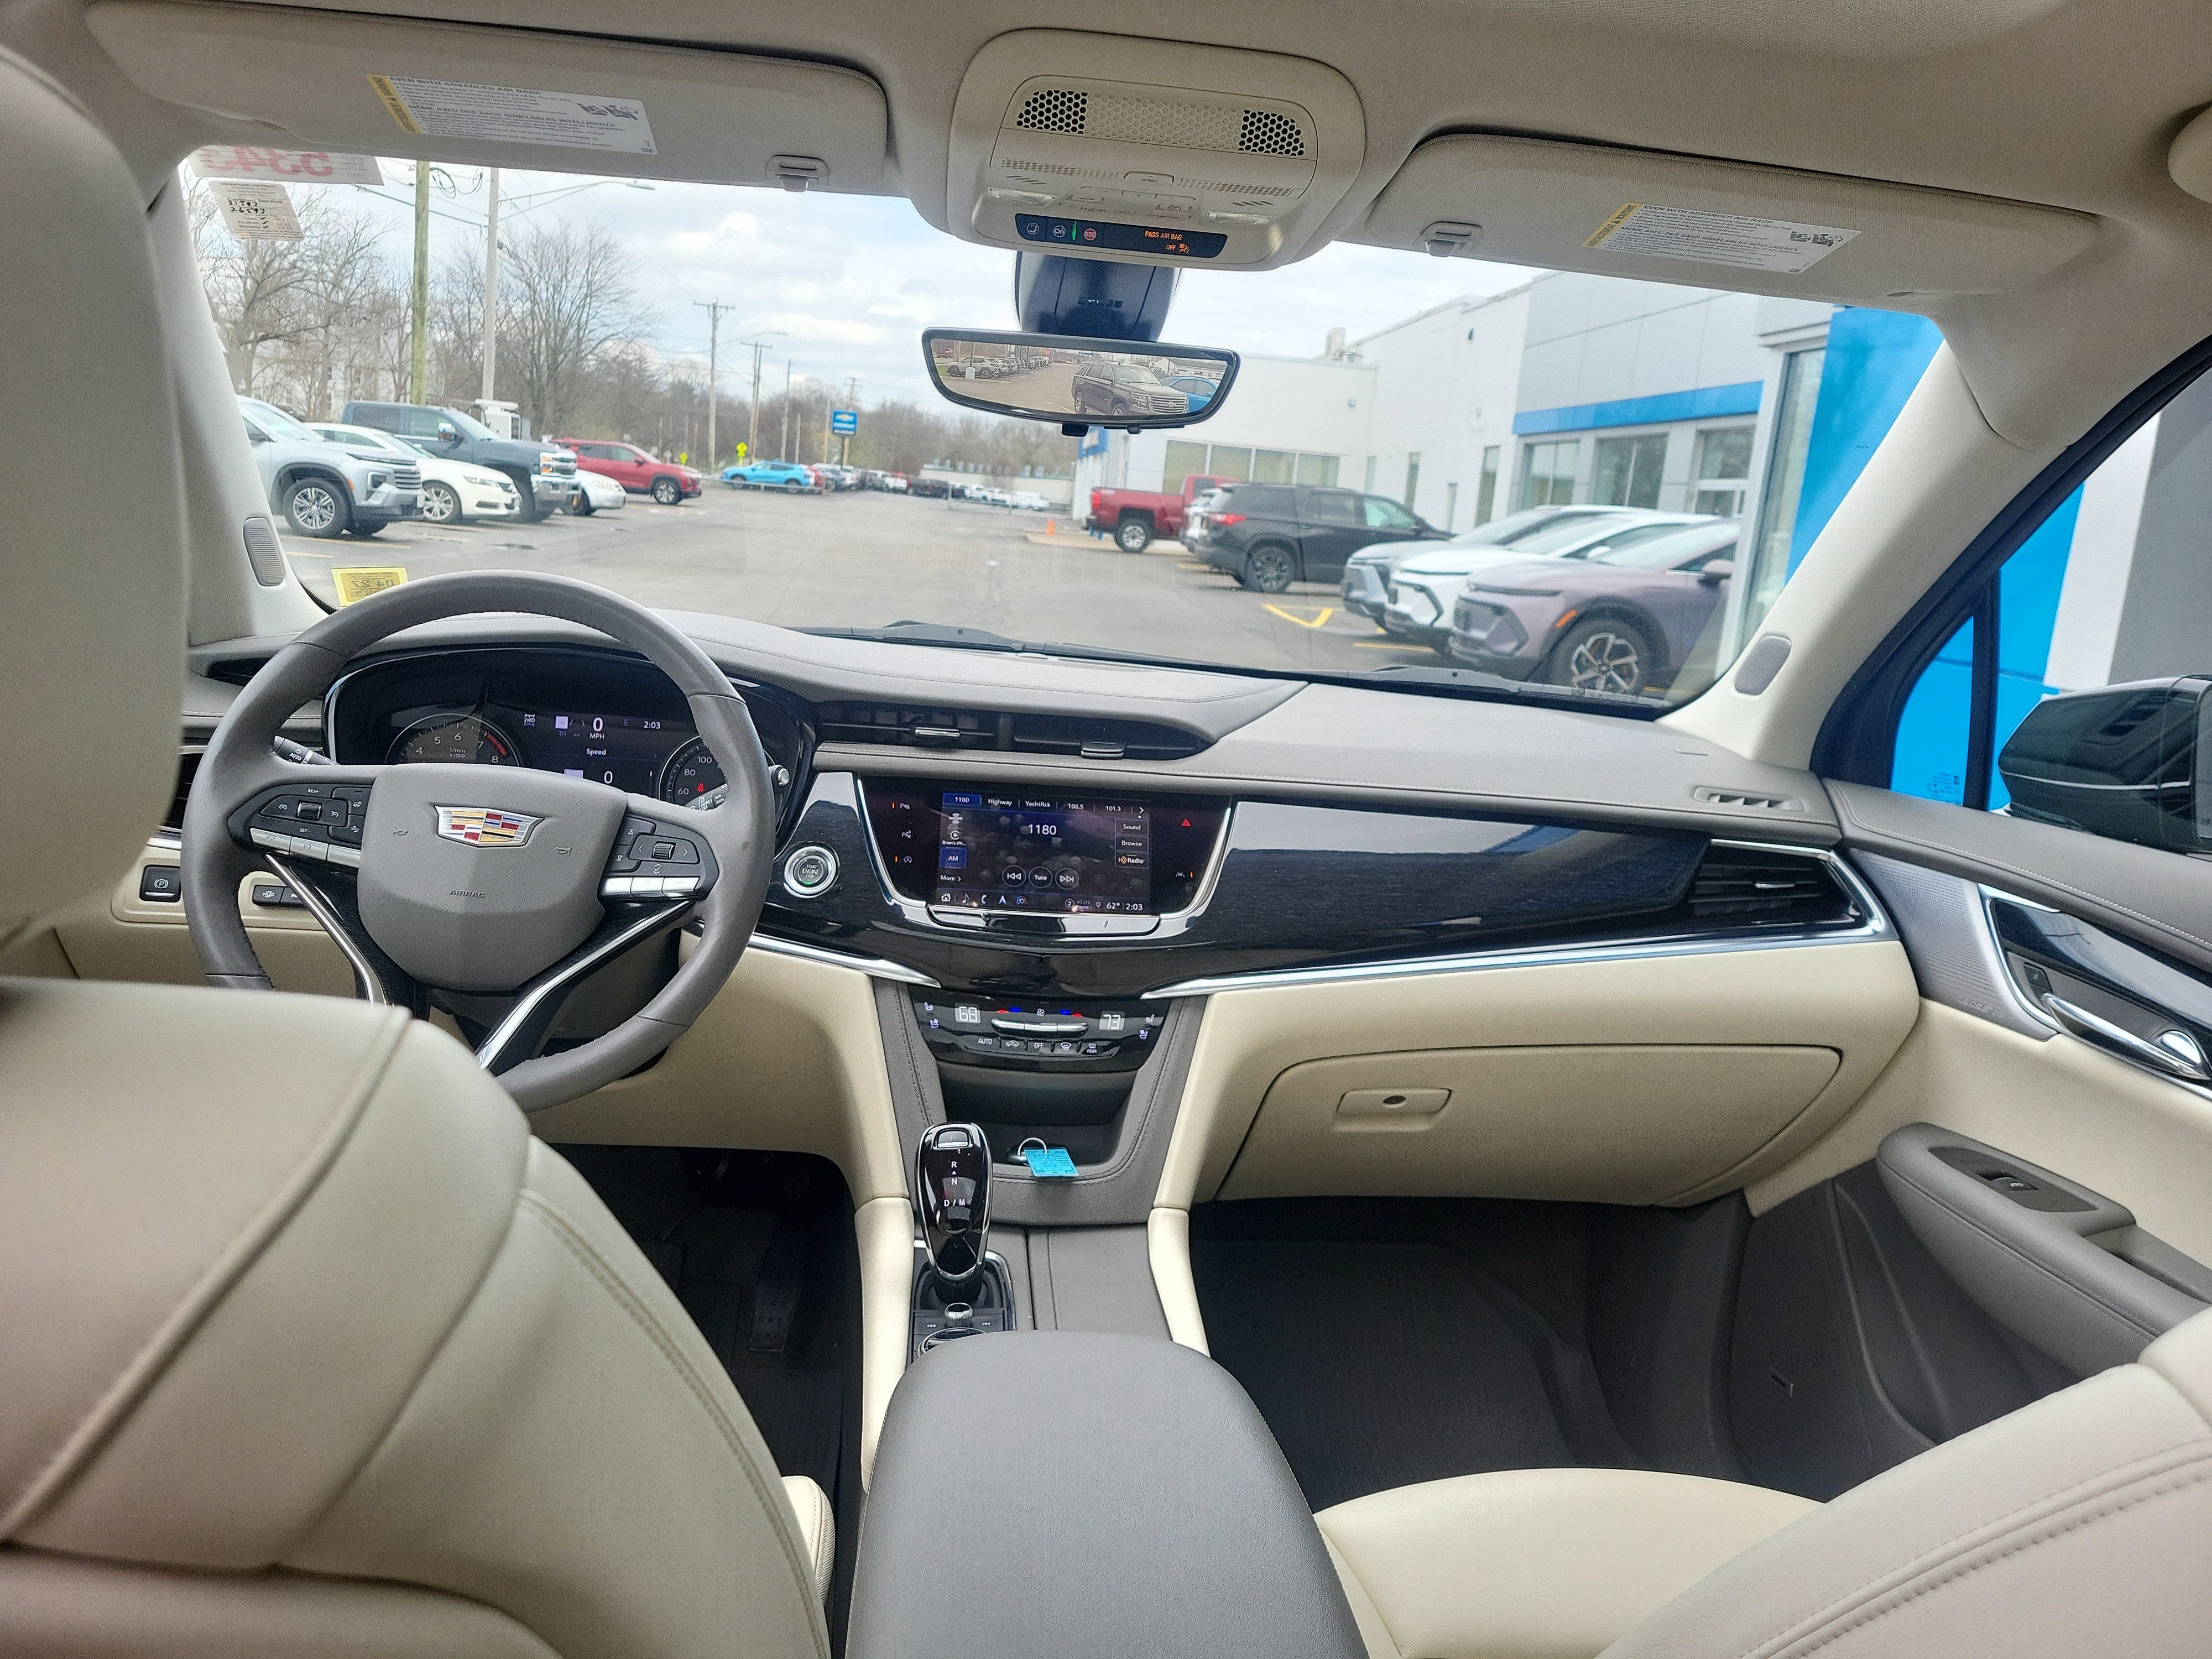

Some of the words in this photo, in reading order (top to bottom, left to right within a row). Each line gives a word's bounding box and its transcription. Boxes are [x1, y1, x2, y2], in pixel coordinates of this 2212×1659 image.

[1145, 230, 1159, 238] PASS
[1701, 236, 1747, 245] GONFLABLES
[1748, 242, 1799, 252] INTELLIGENTS
[593, 717, 603, 732] 0
[644, 721, 661, 729] 2:03
[477, 741, 484, 749] 7
[289, 753, 302, 761] AUTO
[604, 771, 613, 784] 0
[1028, 823, 1057, 836] 1180
[449, 889, 486, 899] AIRBAG
[959, 1006, 978, 1022] 68
[1103, 1014, 1121, 1029] 73
